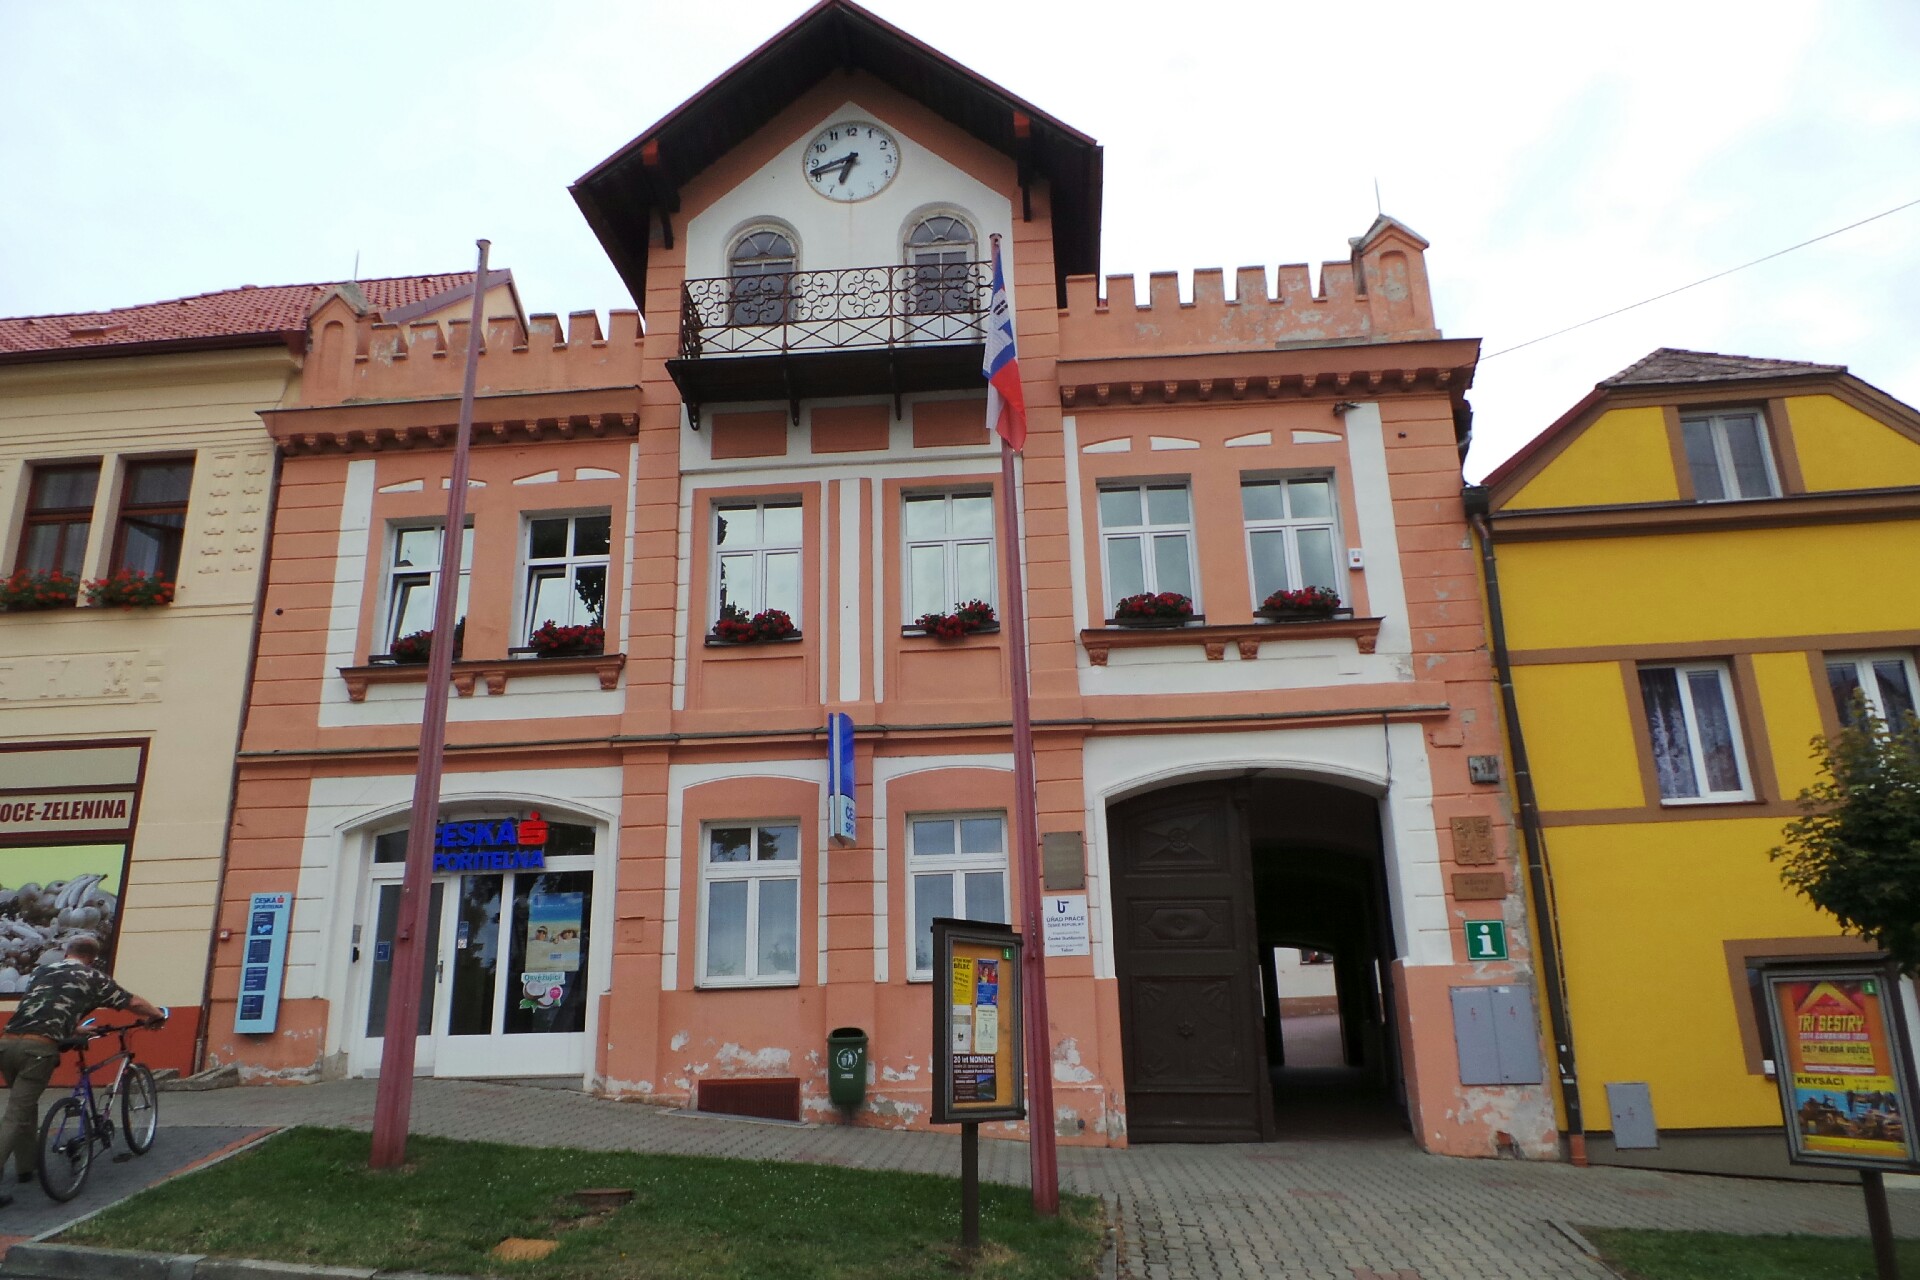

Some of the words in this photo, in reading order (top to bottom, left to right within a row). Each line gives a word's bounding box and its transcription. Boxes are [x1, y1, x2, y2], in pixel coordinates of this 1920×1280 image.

[830, 131, 838, 140] 11
[846, 127, 858, 137] 12
[867, 128, 874, 138] 1
[816, 143, 827, 153] 10
[879, 140, 888, 150] 2
[811, 158, 820, 167] 9
[885, 154, 892, 163] 3
[815, 173, 822, 183] 8
[828, 184, 835, 194] 7
[0, 799, 126, 823] OCE-ZELENINA
[433, 849, 545, 872] POŘITELNA
[1818, 1015, 1864, 1032] SESTRY
[953, 1055, 961, 1063] 20
